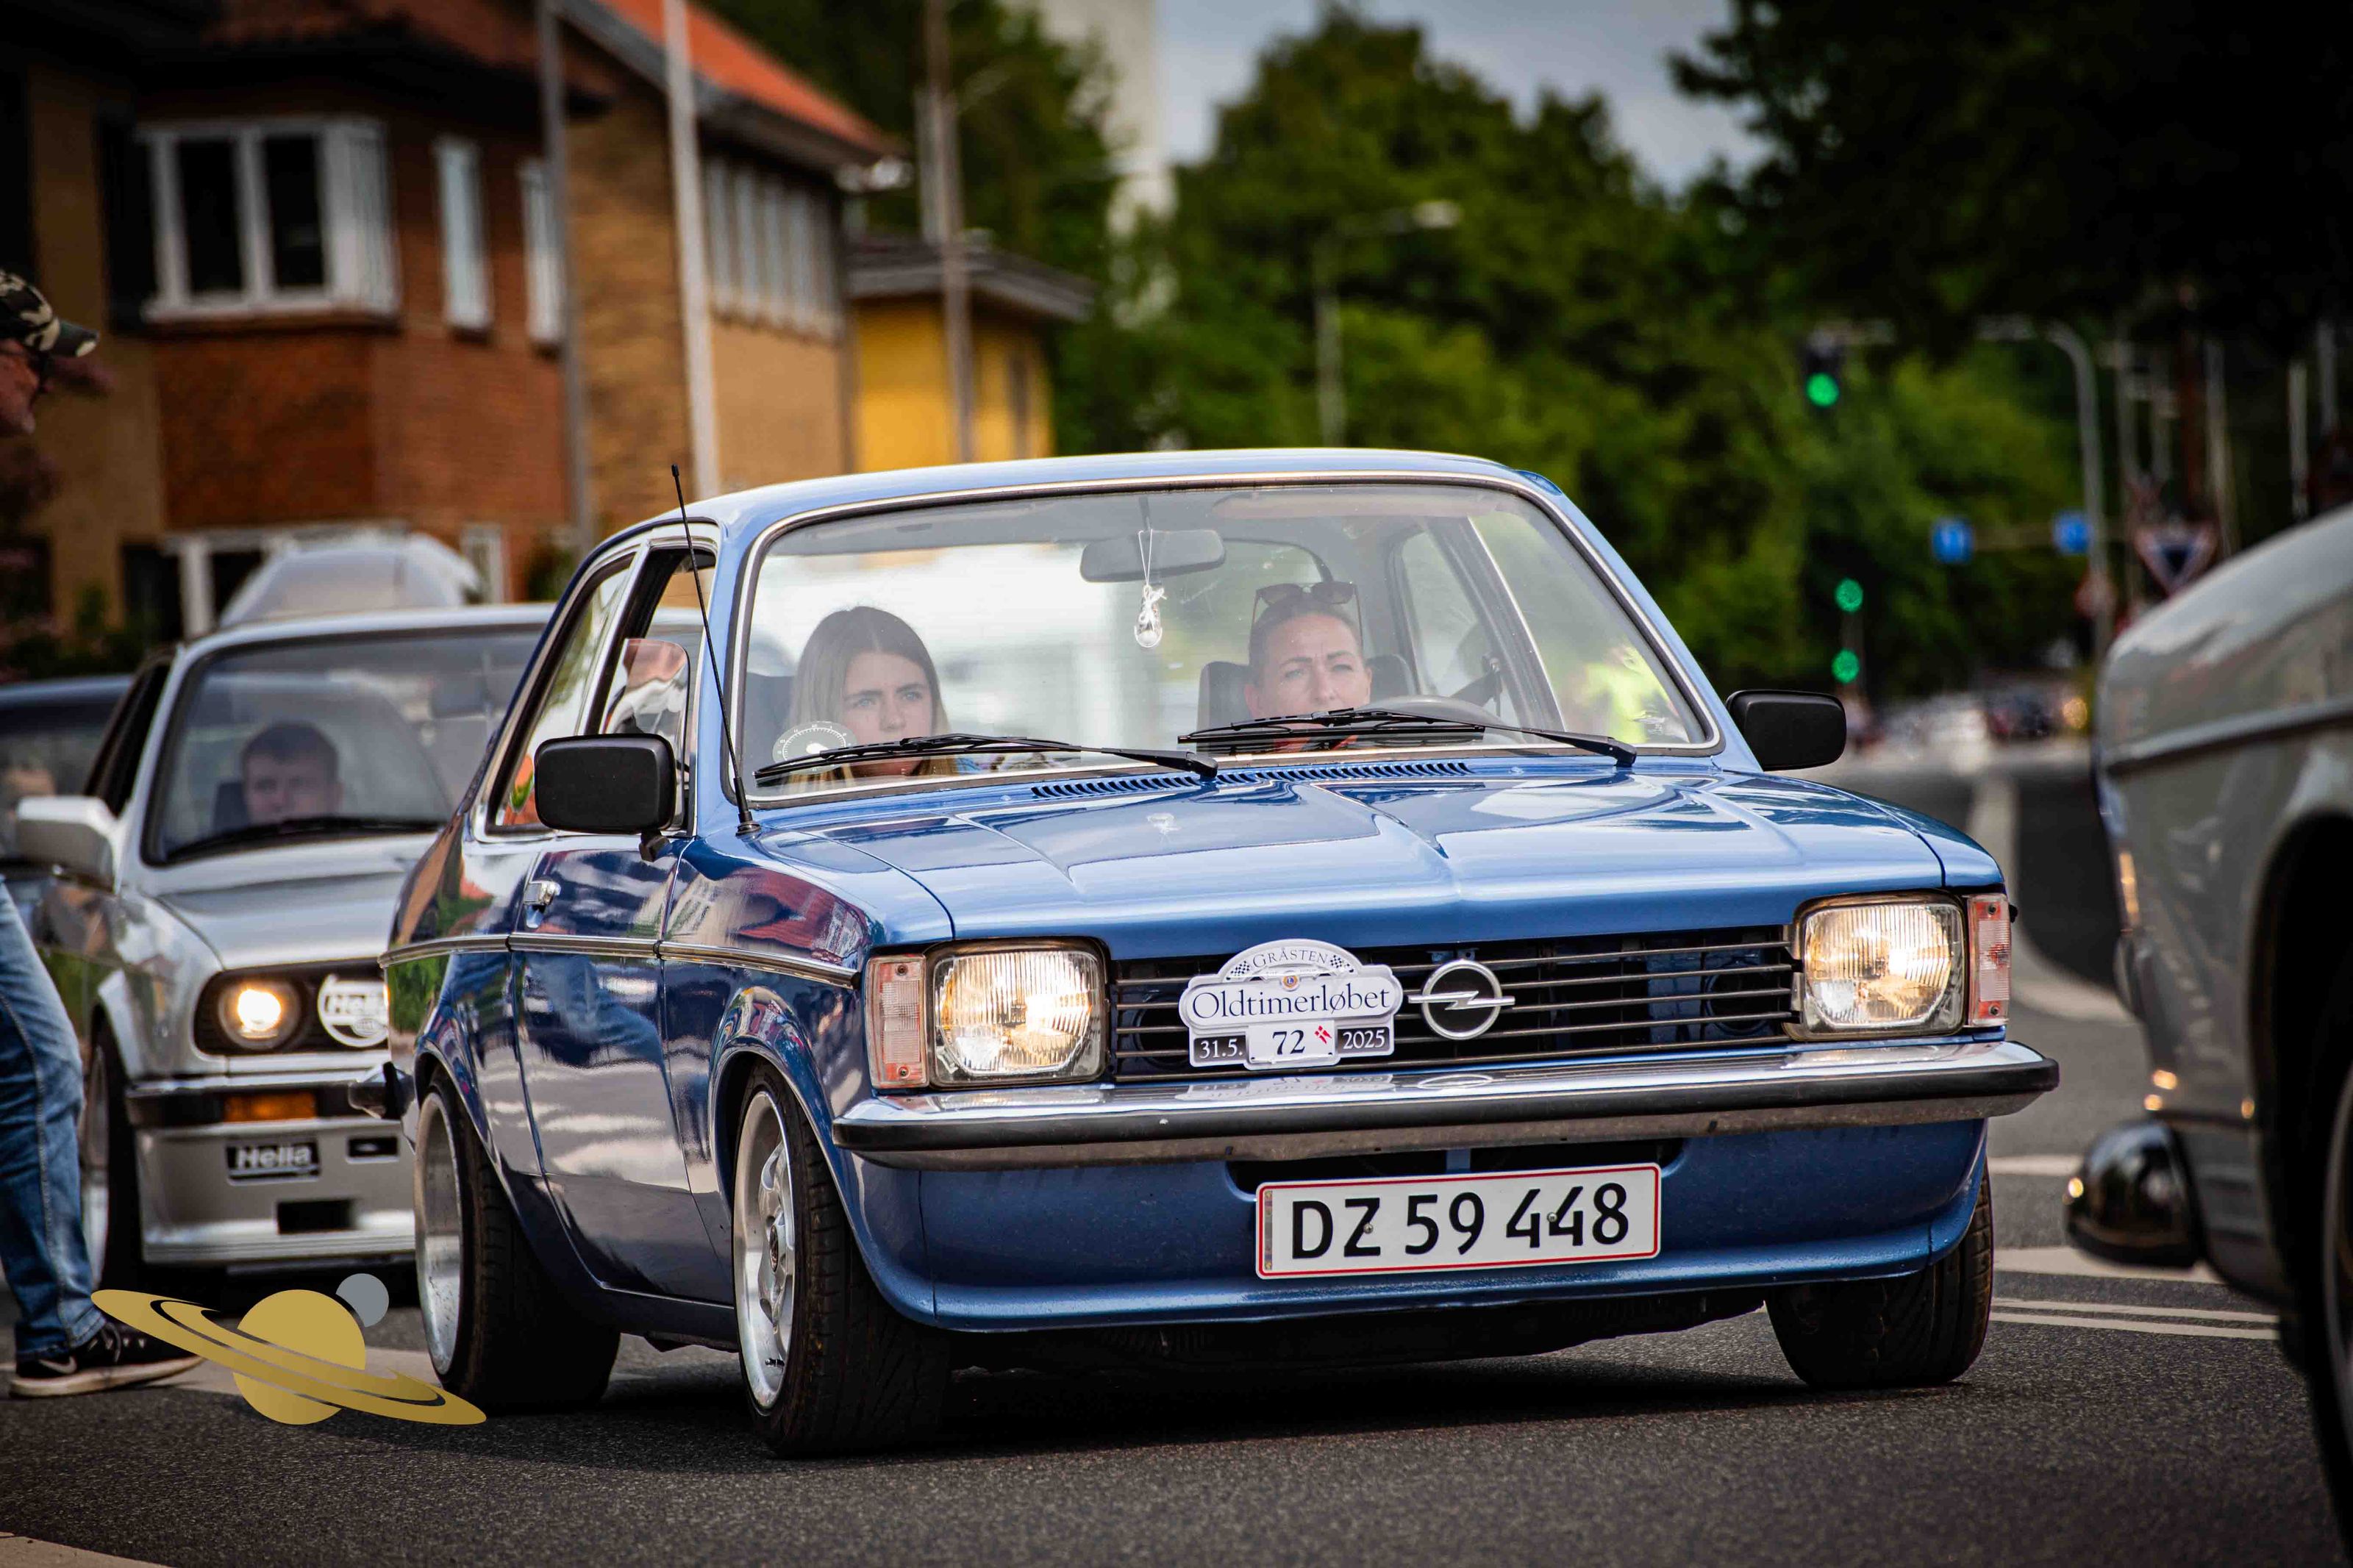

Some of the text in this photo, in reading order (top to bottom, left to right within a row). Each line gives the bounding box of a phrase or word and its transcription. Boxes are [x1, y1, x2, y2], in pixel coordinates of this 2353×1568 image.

[1252, 948, 1329, 968] GRÅSTEN
[1192, 983, 1390, 1020] Oldtimerløbet
[1199, 1028, 1386, 1060] 31.5. 72 2025
[237, 1145, 312, 1170] Hella
[1291, 1181, 1629, 1260] DZ 59 448
